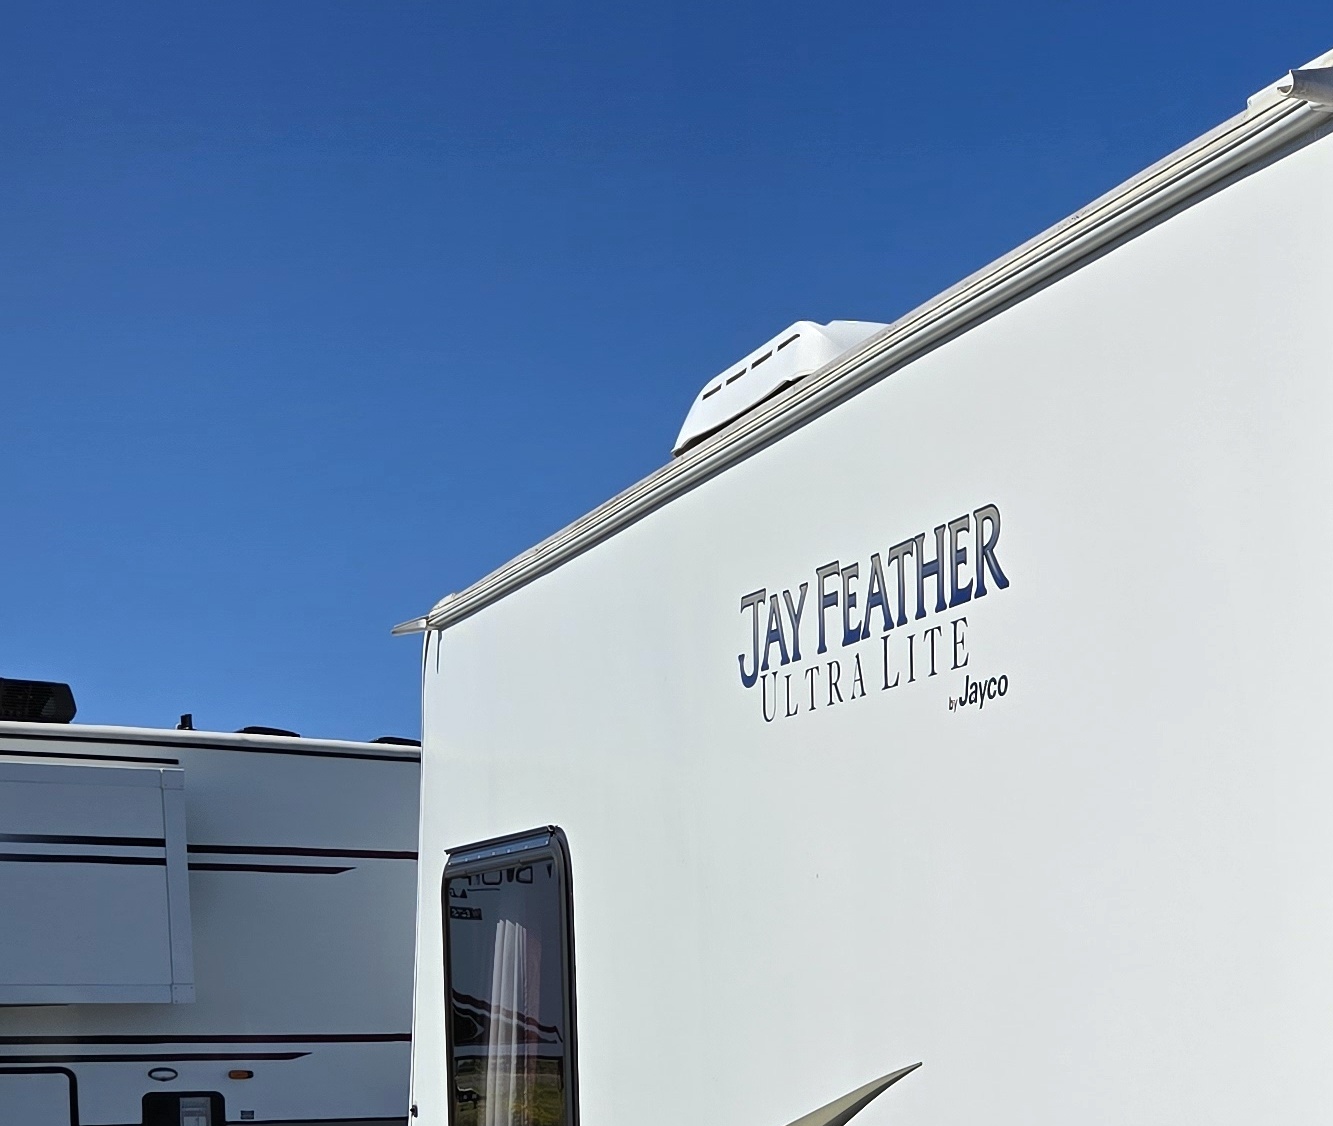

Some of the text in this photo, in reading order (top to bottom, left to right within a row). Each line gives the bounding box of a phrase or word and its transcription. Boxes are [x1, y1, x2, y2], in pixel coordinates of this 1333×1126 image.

[738, 503, 1010, 689] JAY FEATHER
[760, 616, 970, 723] ULTRA LITE
[949, 673, 1009, 713] by Jayco
